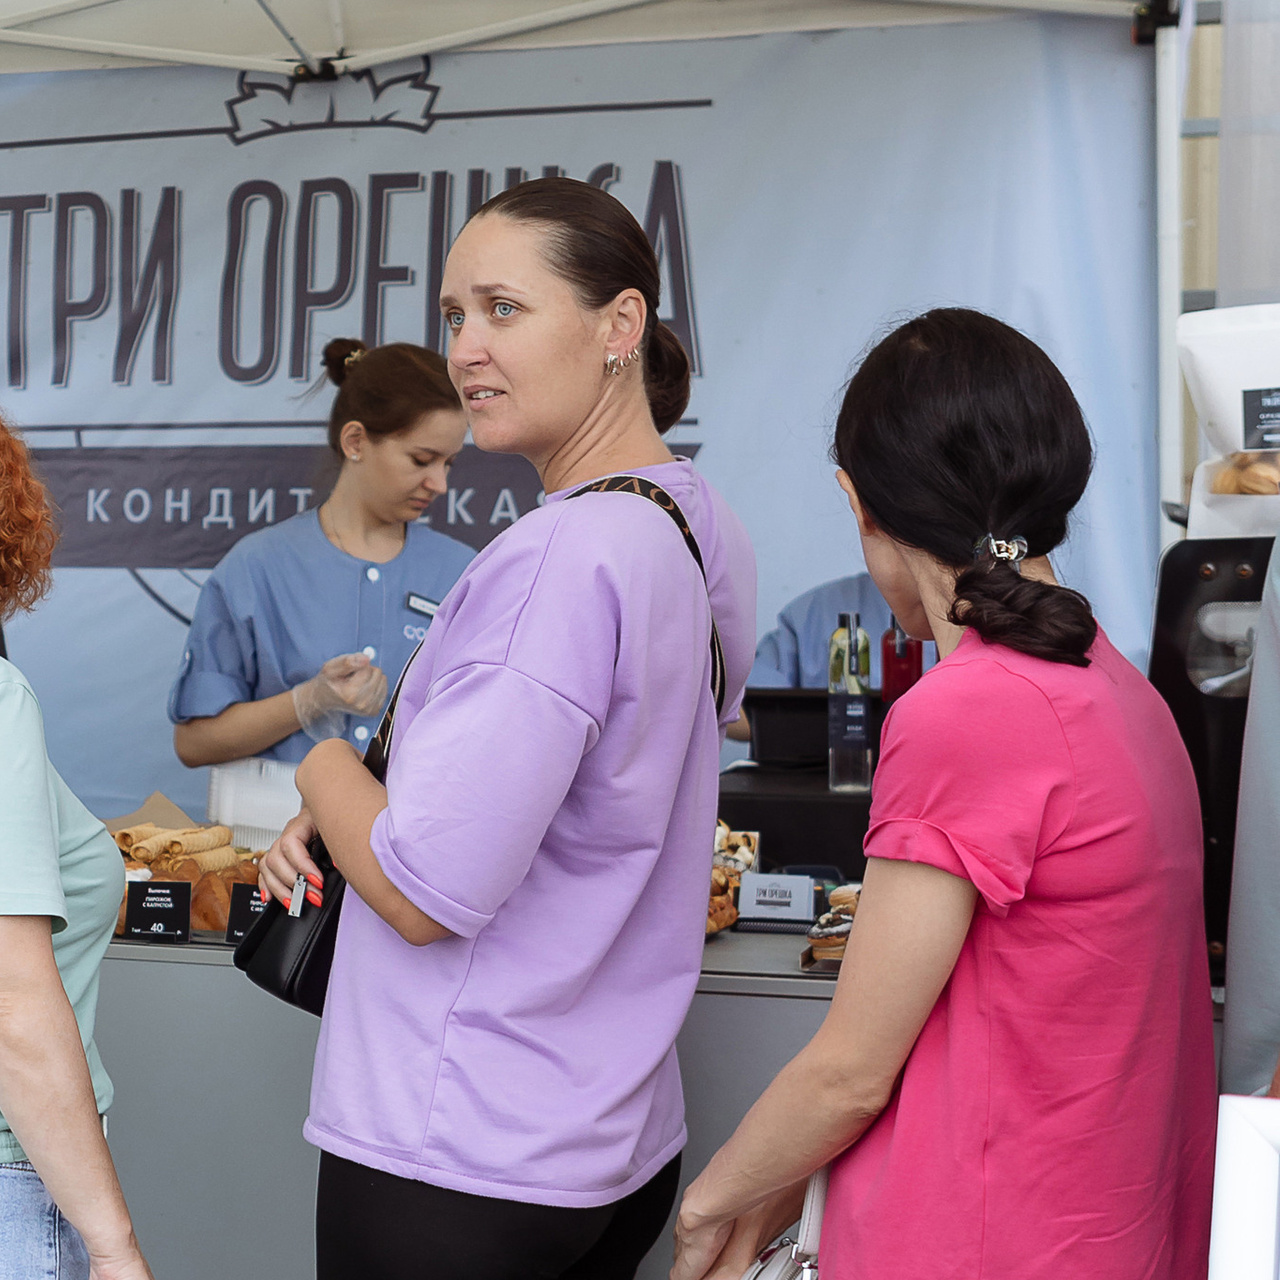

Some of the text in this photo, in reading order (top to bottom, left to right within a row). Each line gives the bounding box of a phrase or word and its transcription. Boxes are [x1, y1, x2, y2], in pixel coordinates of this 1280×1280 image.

[218, 159, 704, 386] ОРЕА
[86, 488, 546, 529] КОНДИТКА
[150, 923, 164, 933] 40
